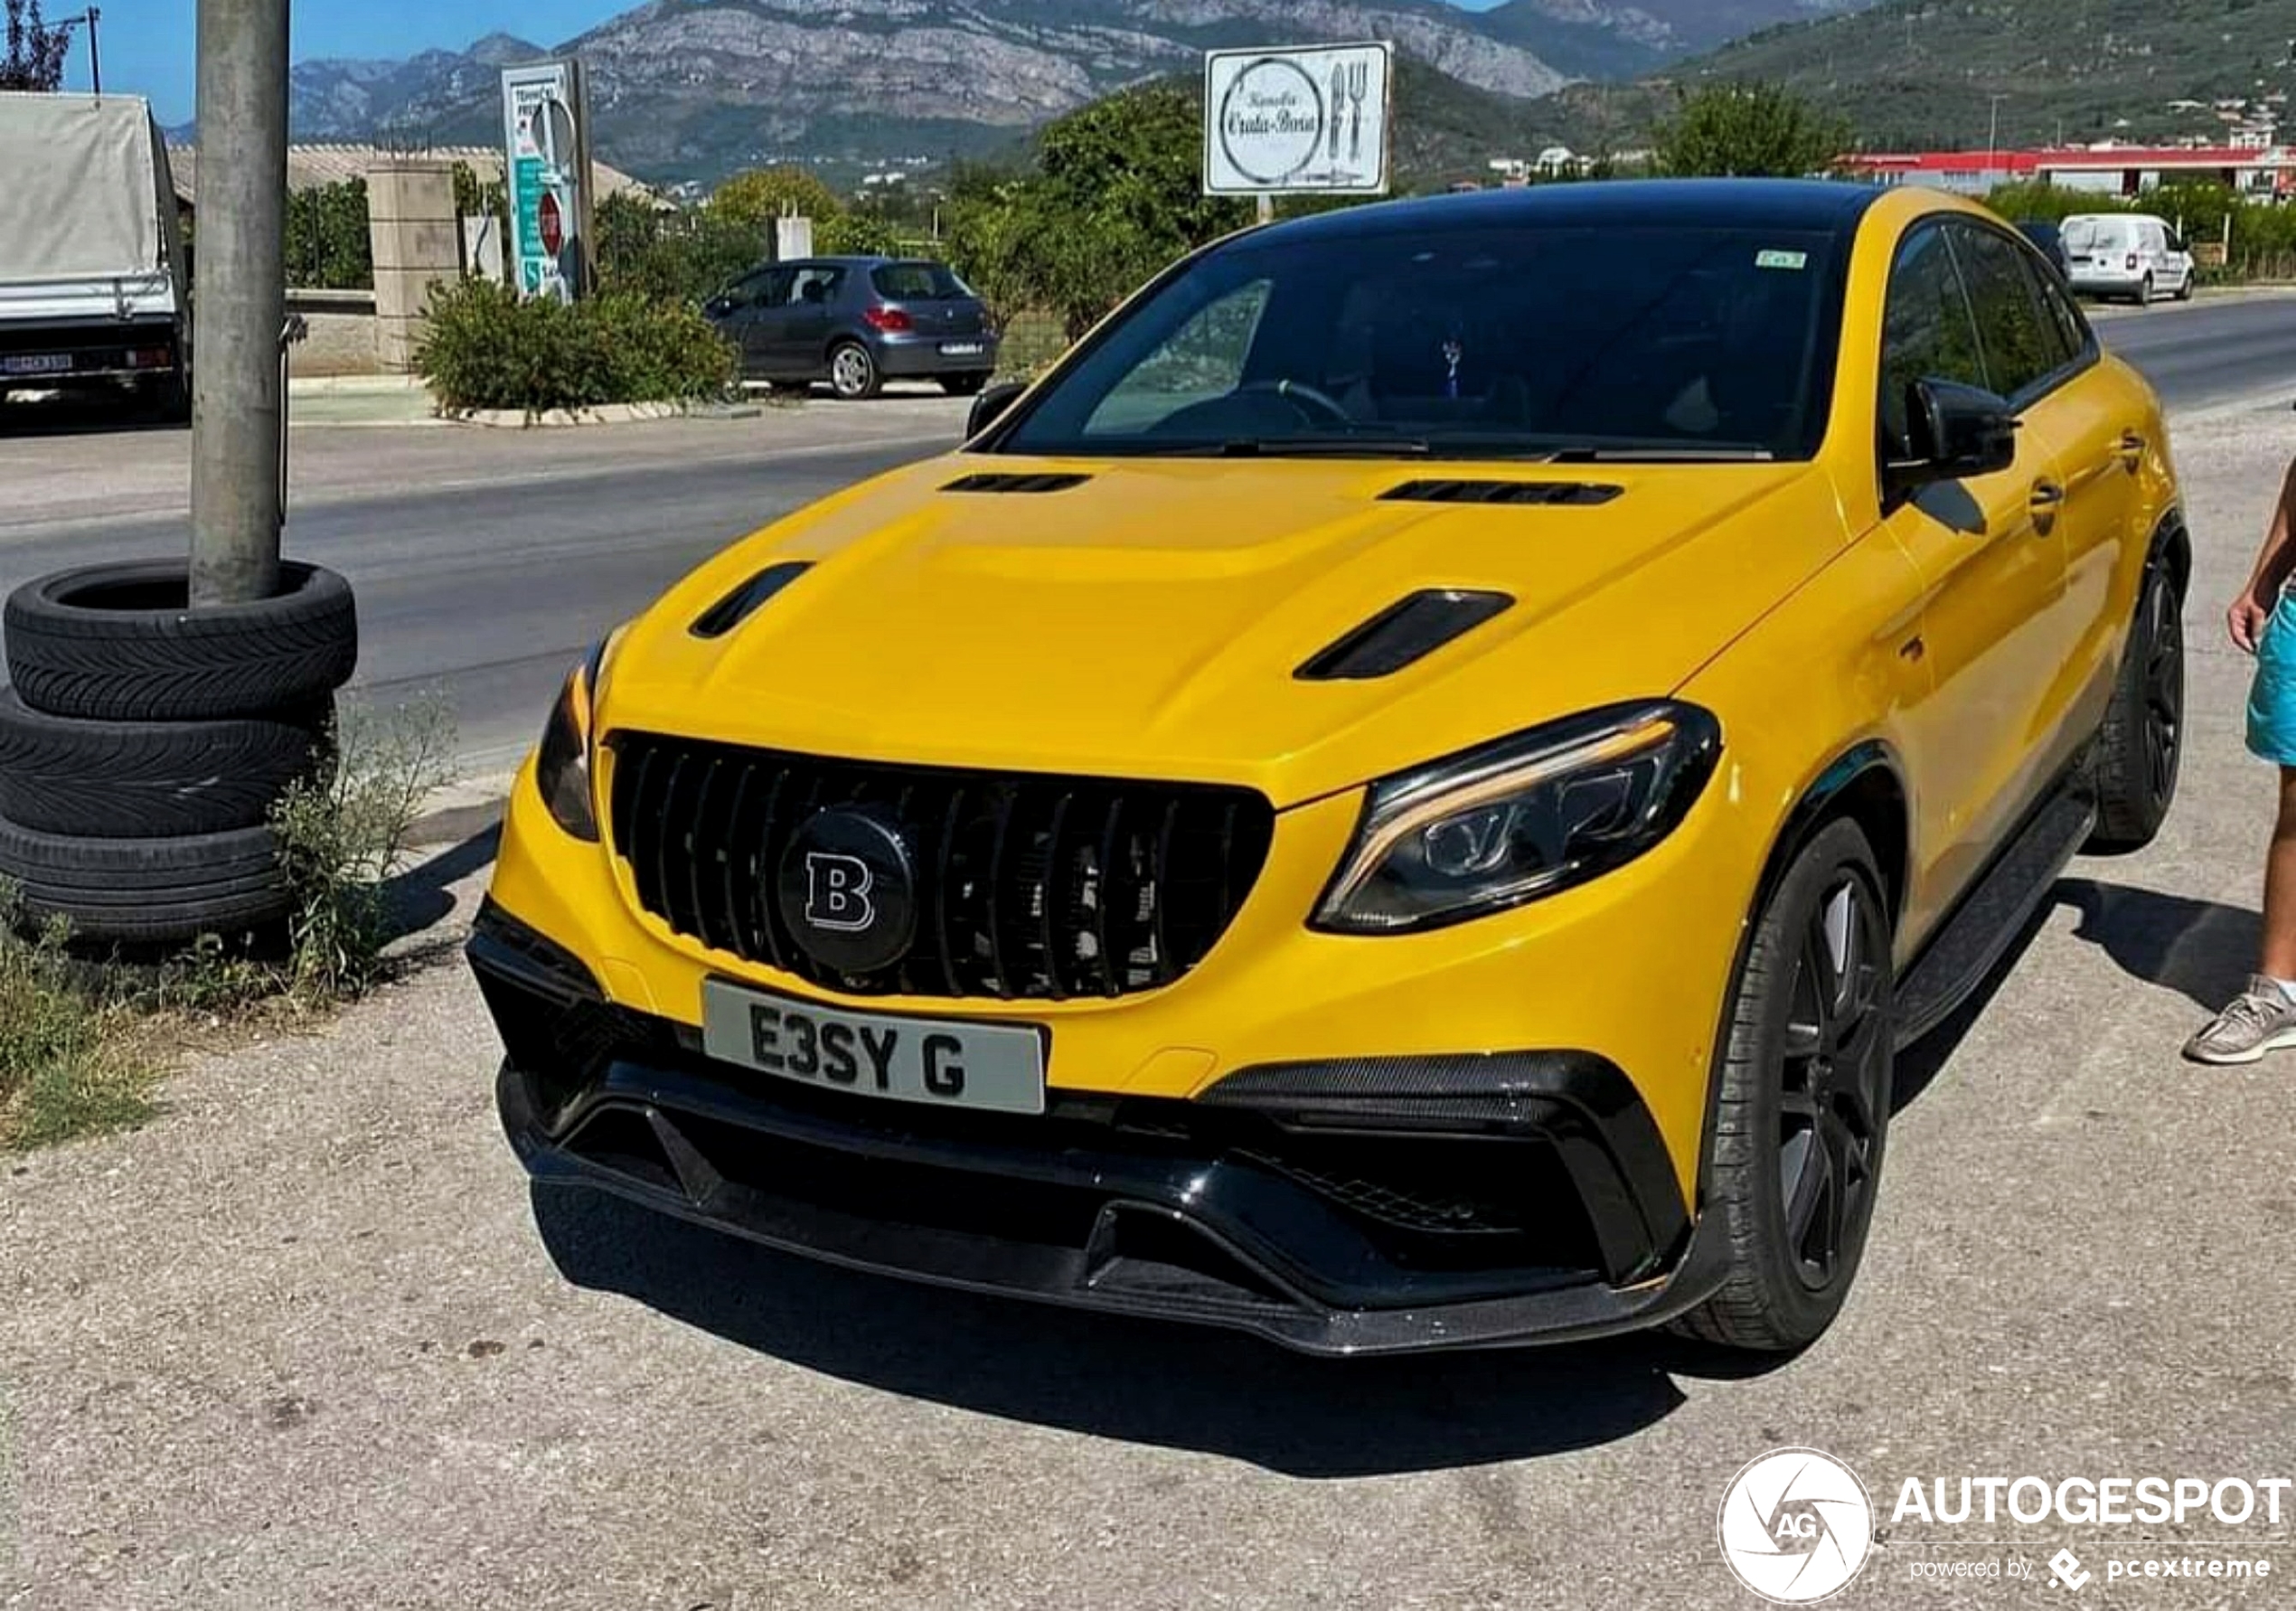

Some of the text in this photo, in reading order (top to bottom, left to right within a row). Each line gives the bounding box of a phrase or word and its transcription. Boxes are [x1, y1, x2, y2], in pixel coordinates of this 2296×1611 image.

[805, 853, 875, 931] B
[749, 1003, 965, 1098] E3SY G
